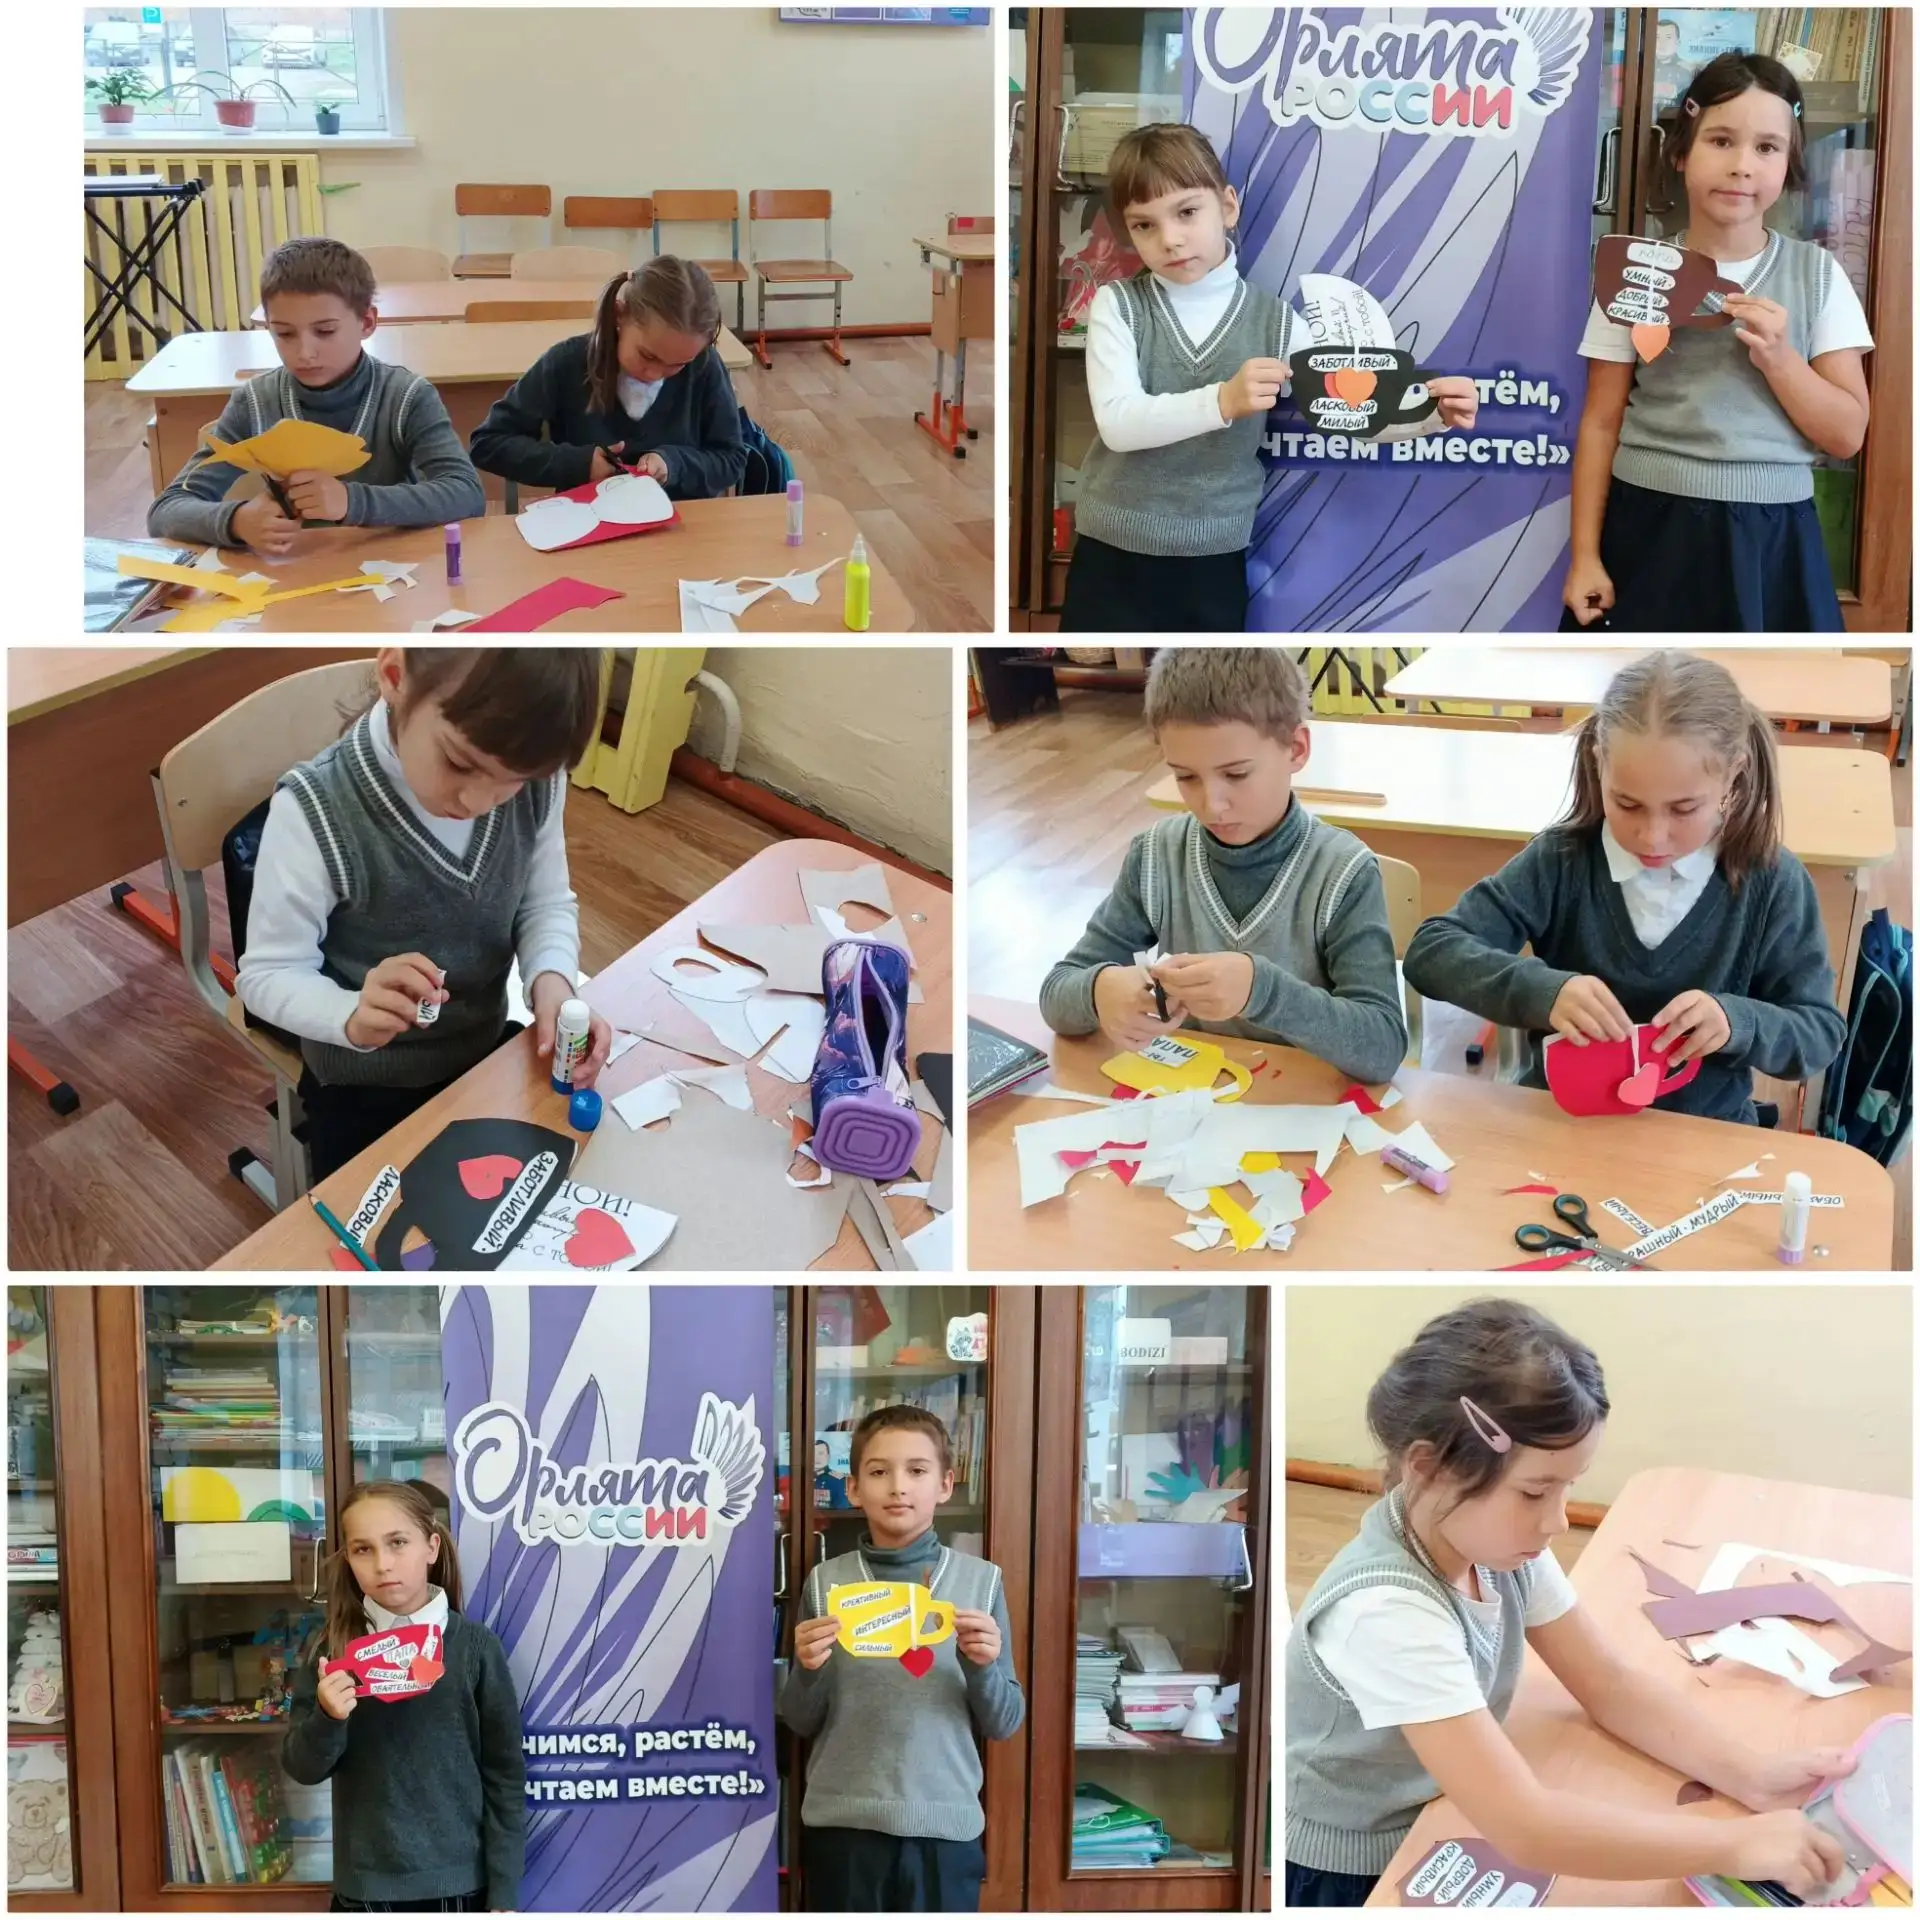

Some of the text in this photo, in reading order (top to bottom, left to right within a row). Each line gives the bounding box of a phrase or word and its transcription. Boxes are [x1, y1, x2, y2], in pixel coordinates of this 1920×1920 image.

[1608, 303, 1666, 324] КРАСИВЙ
[1617, 290, 1662, 307] ДОБРЙ
[1310, 400, 1376, 413] ЛАСКОЫЙ
[1320, 417, 1366, 429] МИЛЫЙ
[483, 1152, 555, 1250] ЗАБОТЛИВЫЙ
[1689, 1194, 1740, 1230] МУДРЫЙ
[463, 1408, 709, 1527] Орлята
[528, 1506, 706, 1540] РОССИИ
[841, 1588, 892, 1609] КРЕАТИВНЫЙ
[855, 1605, 912, 1636] ИНТЕРЕСНЫЙ
[357, 1637, 396, 1660] СМЕЛЫЙ
[635, 1722, 756, 1758] растём,
[628, 1770, 766, 1798] вместе!»
[1411, 1843, 1458, 1895] КРАСИВЫЙ
[1437, 1857, 1476, 1901] ДОБРЫЙ
